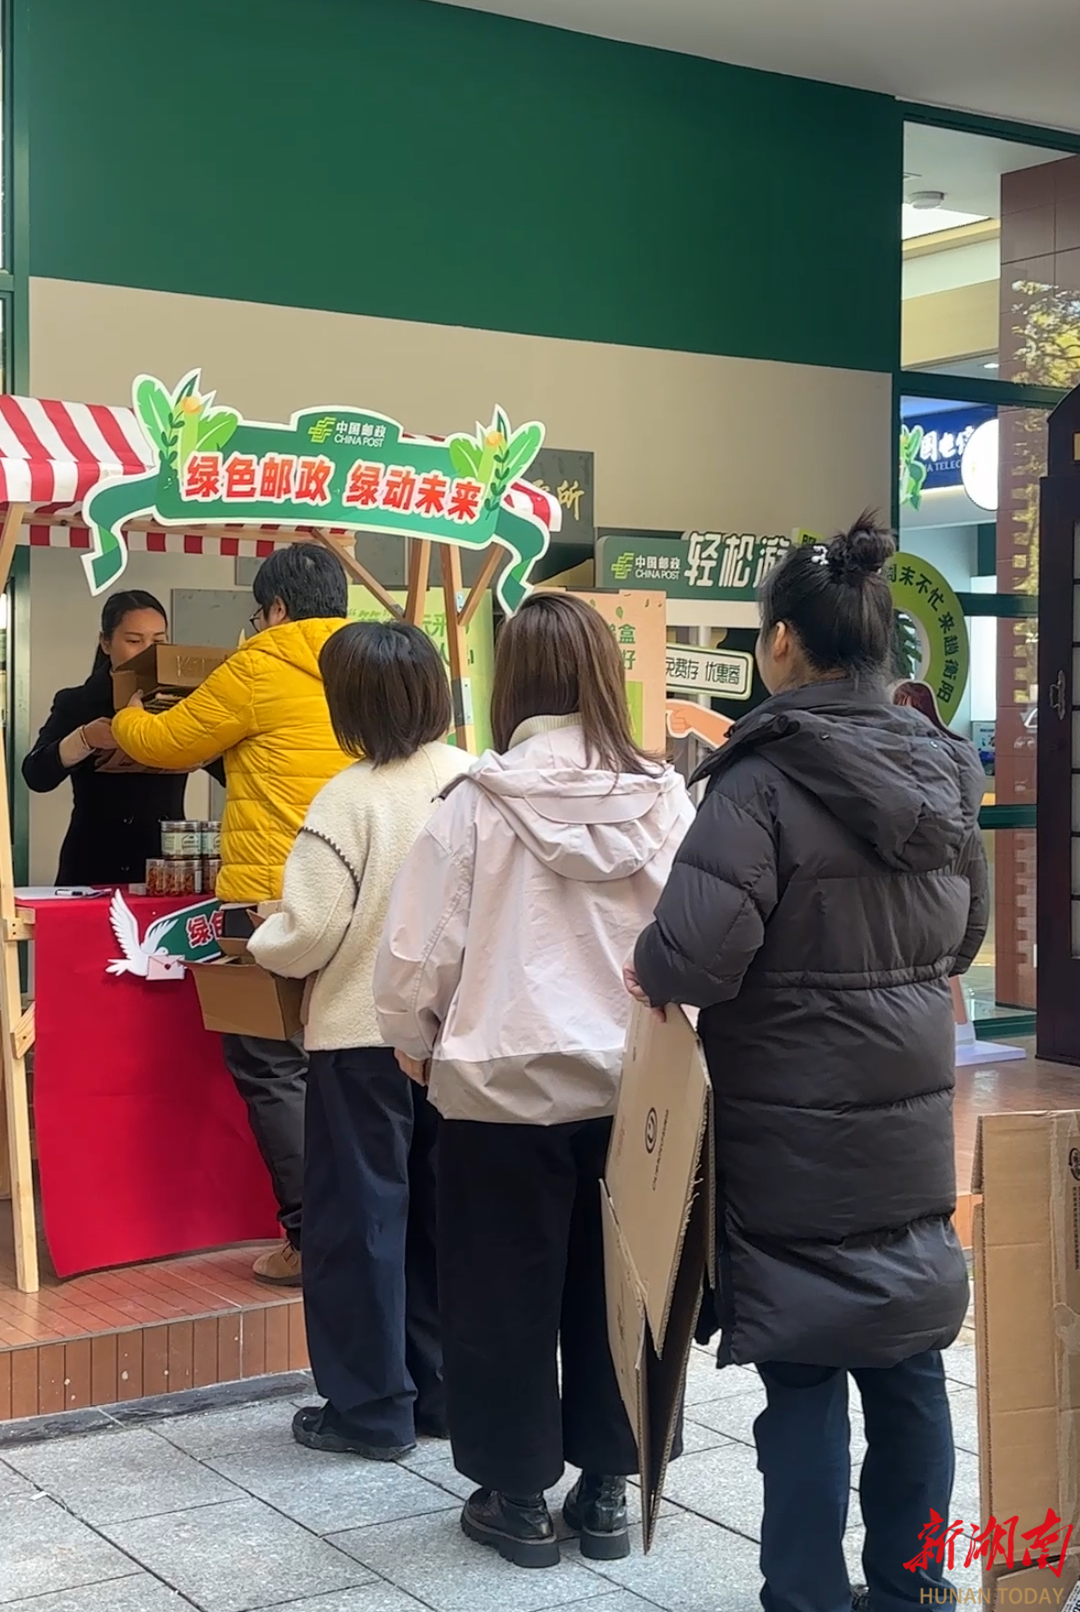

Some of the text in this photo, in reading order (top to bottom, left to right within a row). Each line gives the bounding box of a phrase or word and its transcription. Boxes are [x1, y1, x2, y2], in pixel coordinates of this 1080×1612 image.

[335, 421, 387, 438] 中国邮政
[334, 434, 384, 447] CHINA POST
[185, 454, 482, 521] 绿色邮政 绿动未来
[532, 479, 585, 521] 所
[635, 555, 681, 570] 中国邮政
[635, 569, 680, 580] CHINA POST
